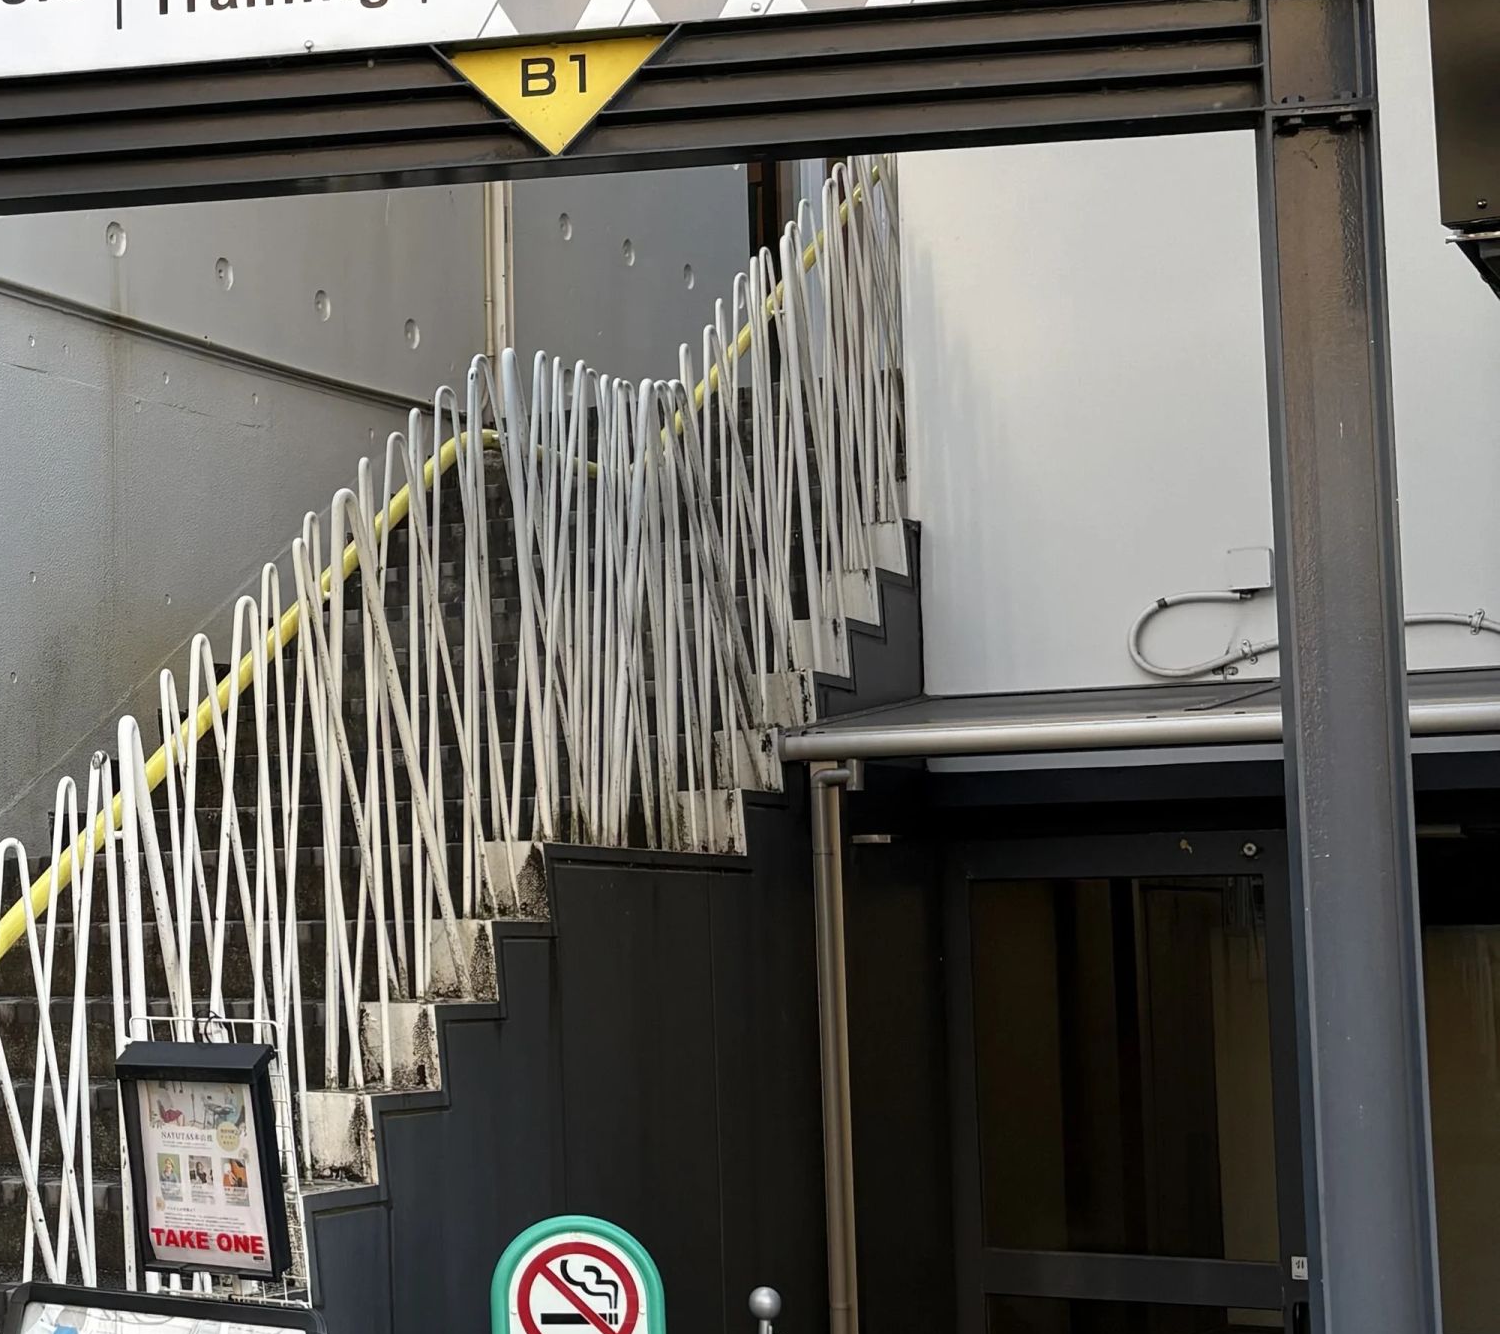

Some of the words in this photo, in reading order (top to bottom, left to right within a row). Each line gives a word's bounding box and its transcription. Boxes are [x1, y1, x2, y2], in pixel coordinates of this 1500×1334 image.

[521, 53, 587, 98] B1
[151, 1228, 211, 1251] TAKE
[216, 1233, 265, 1255] ONE
